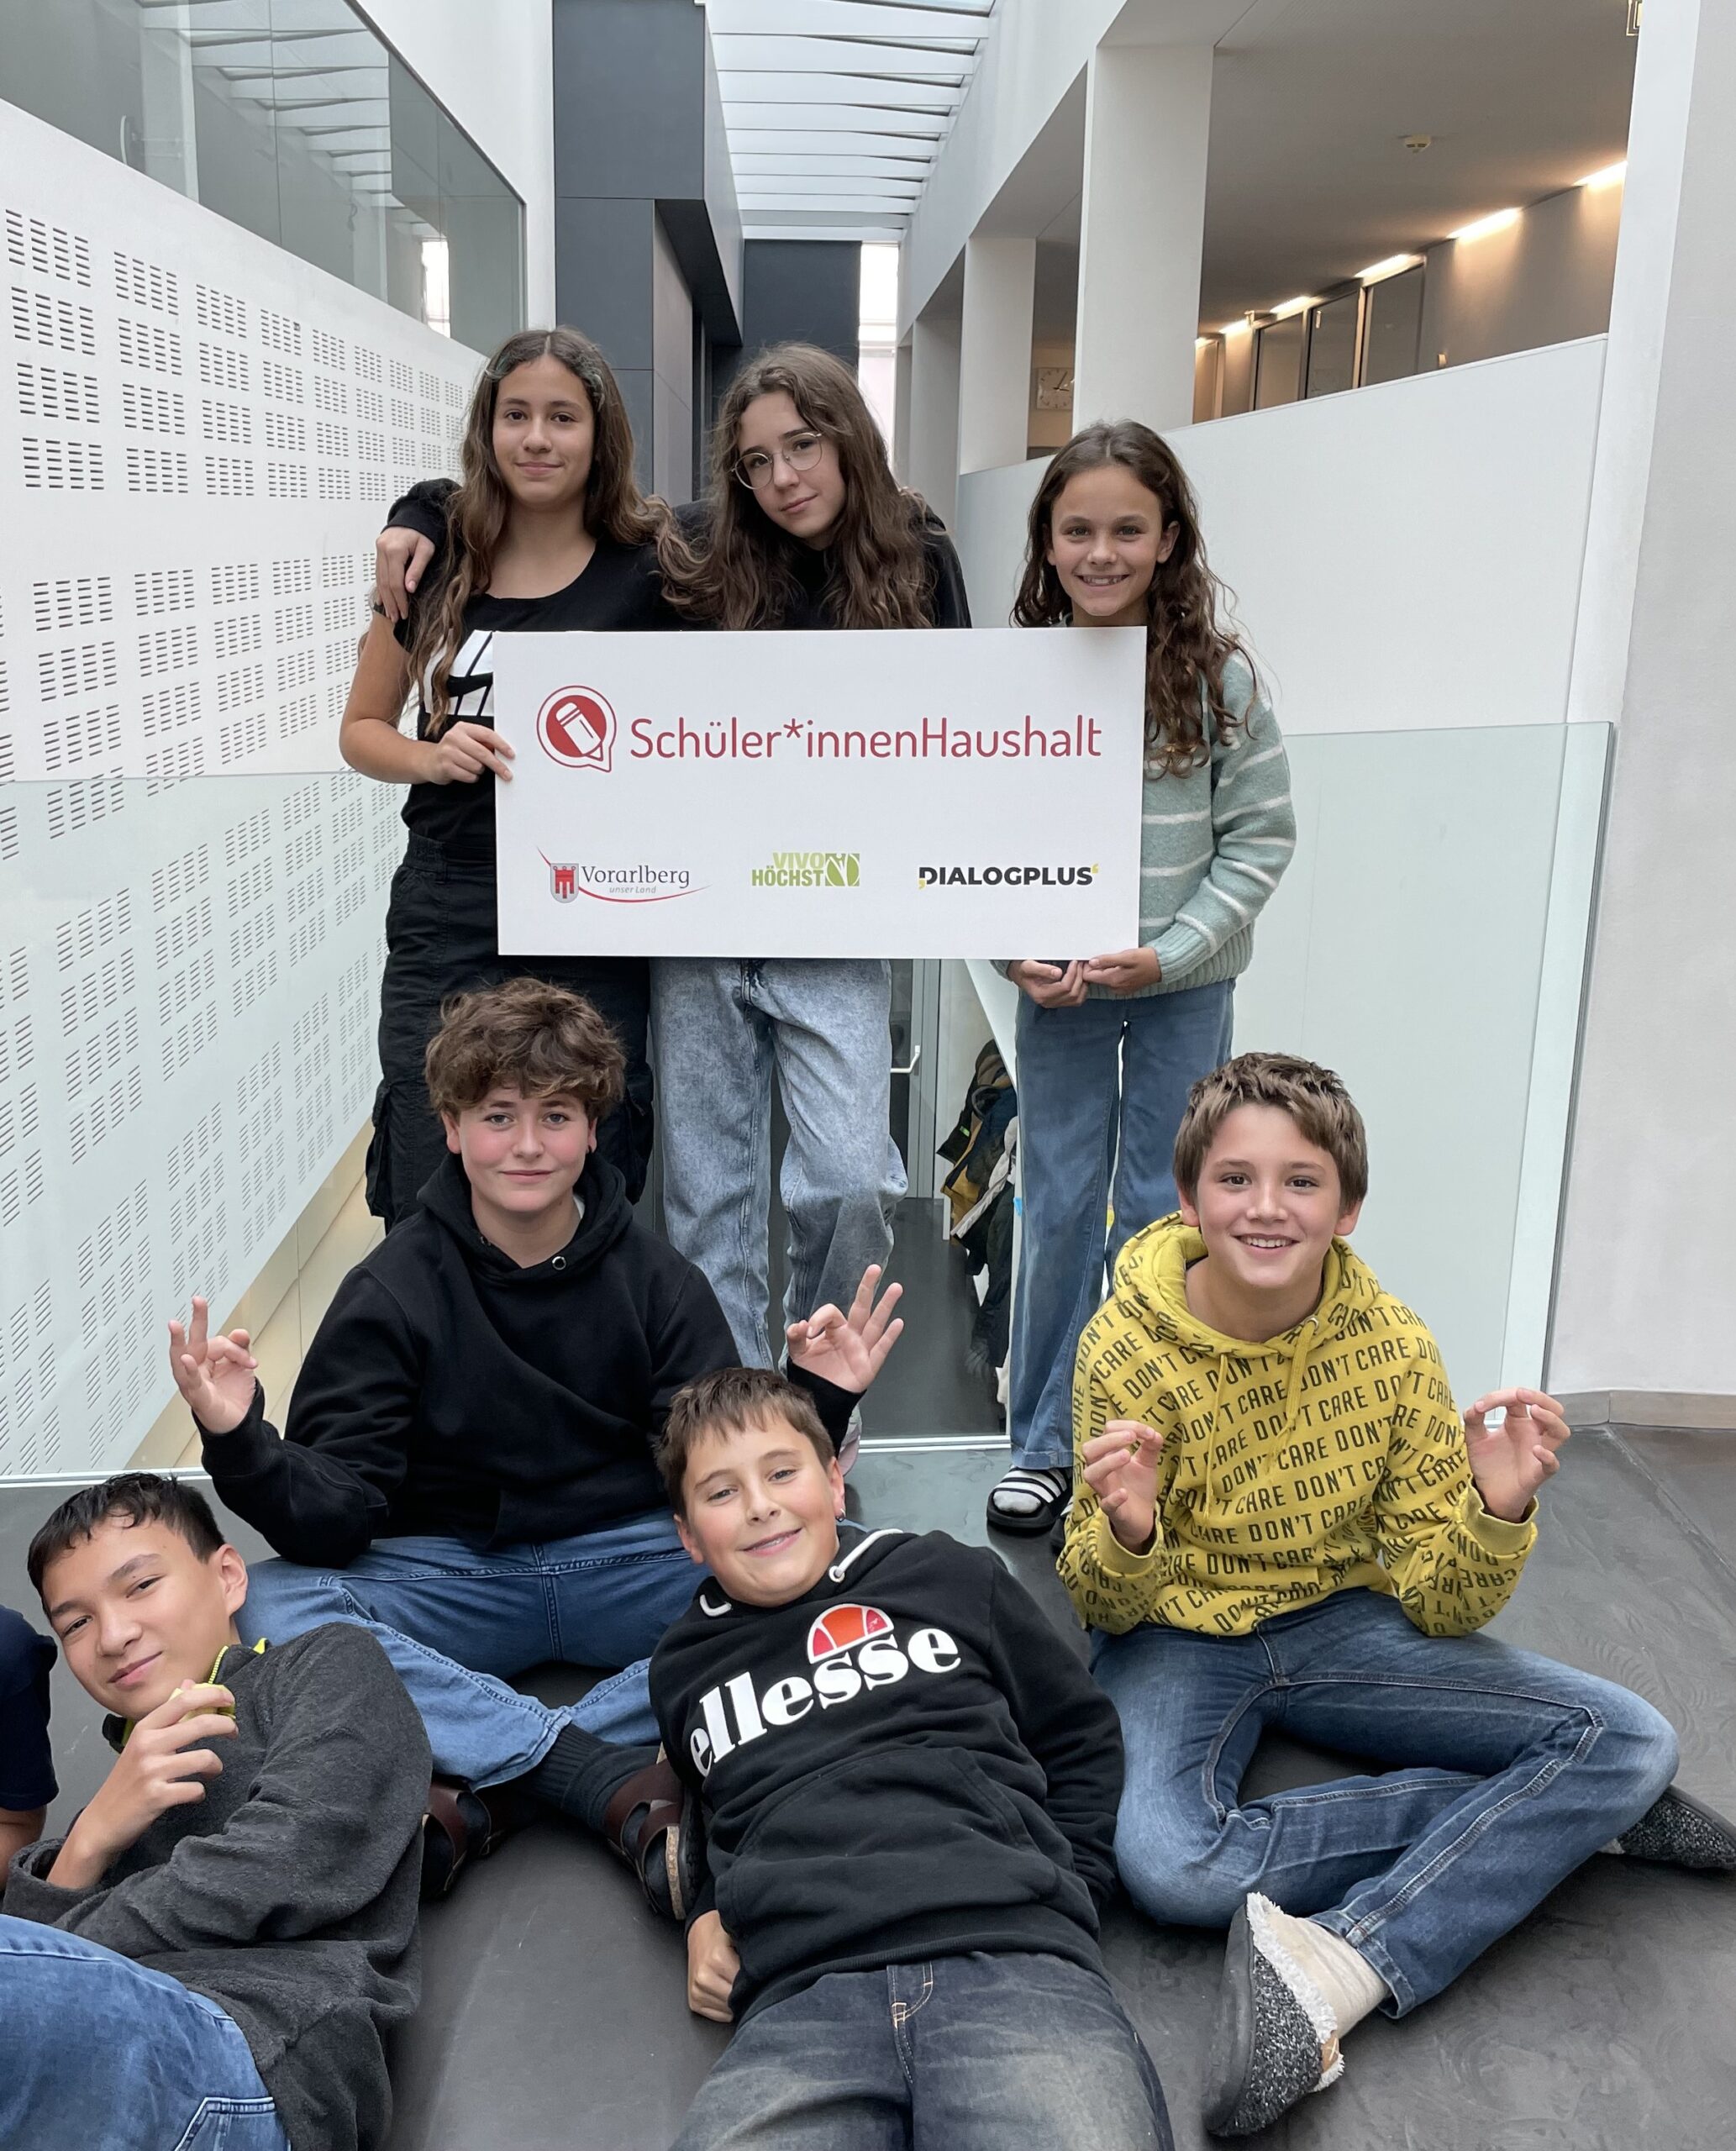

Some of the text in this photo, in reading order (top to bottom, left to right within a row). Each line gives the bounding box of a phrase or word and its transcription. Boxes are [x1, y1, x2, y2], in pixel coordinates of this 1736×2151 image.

[581, 865, 690, 889] Vorarlberg
[751, 865, 824, 887] HÖCHST
[772, 852, 825, 869] VIVO
[635, 885, 656, 894] Land
[1092, 1331, 1143, 1380] CARE
[1123, 1352, 1178, 1400] DON'T
[1238, 1380, 1288, 1415] CARE
[1355, 1337, 1411, 1371] CARE
[1318, 1386, 1369, 1422] CARE
[1278, 1436, 1329, 1470] CARE
[1235, 1486, 1286, 1515] CARE
[1295, 1465, 1356, 1501] DON'T
[1248, 1513, 1313, 1543] DON'T
[690, 1628, 961, 1777] ellesse
